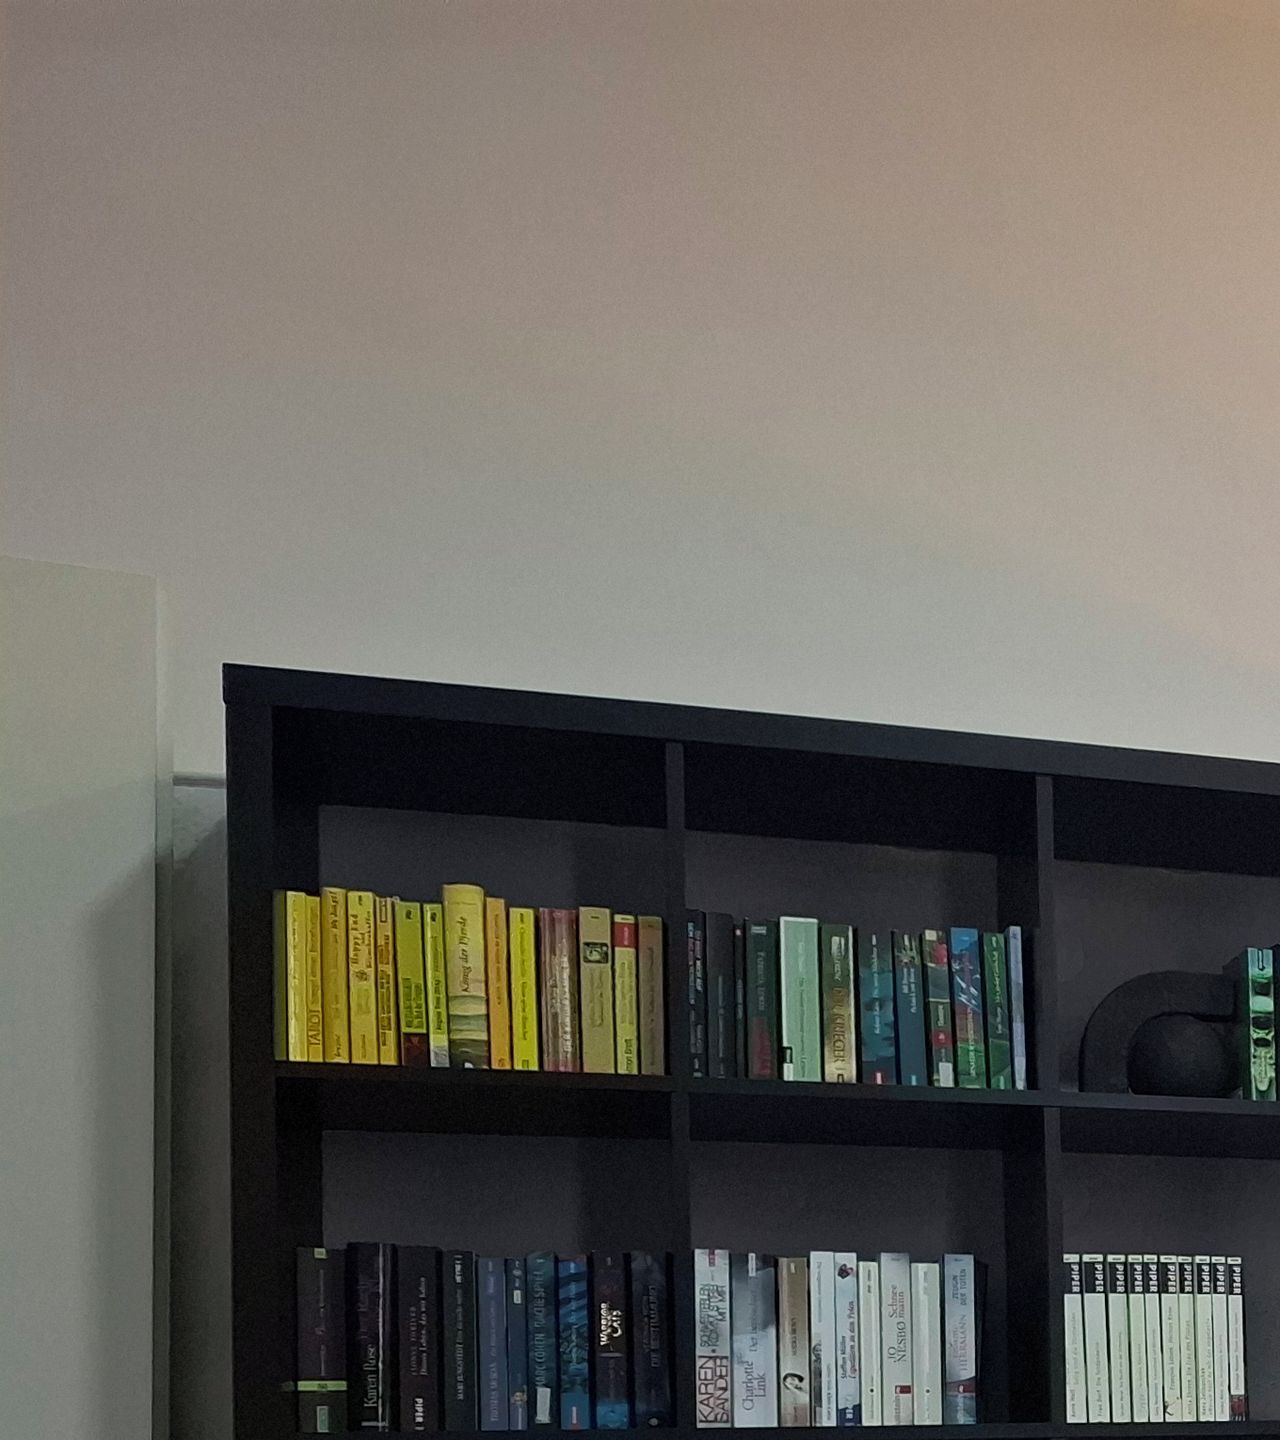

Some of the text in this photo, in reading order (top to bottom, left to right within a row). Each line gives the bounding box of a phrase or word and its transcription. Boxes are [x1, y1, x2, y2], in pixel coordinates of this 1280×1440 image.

[1071, 1264, 1079, 1292] PIPER
[1095, 1263, 1103, 1292] PIPER
[1116, 1264, 1124, 1292] PIPER
[1134, 1264, 1142, 1292] PIPER
[1149, 1264, 1157, 1292] PIPER
[1168, 1265, 1176, 1292] PIPER
[1184, 1265, 1192, 1292] PIPER
[1202, 1265, 1210, 1292] PIPER
[1216, 1265, 1224, 1292] PIPER
[1233, 1267, 1241, 1294] PIPER
[887, 1346, 897, 1363] JO
[362, 1344, 377, 1407] Karen Rose
[698, 1355, 714, 1423] KAREN
[714, 1355, 729, 1423] SANDER
[742, 1361, 754, 1411] Charlotte
[754, 1373, 767, 1398] Link
